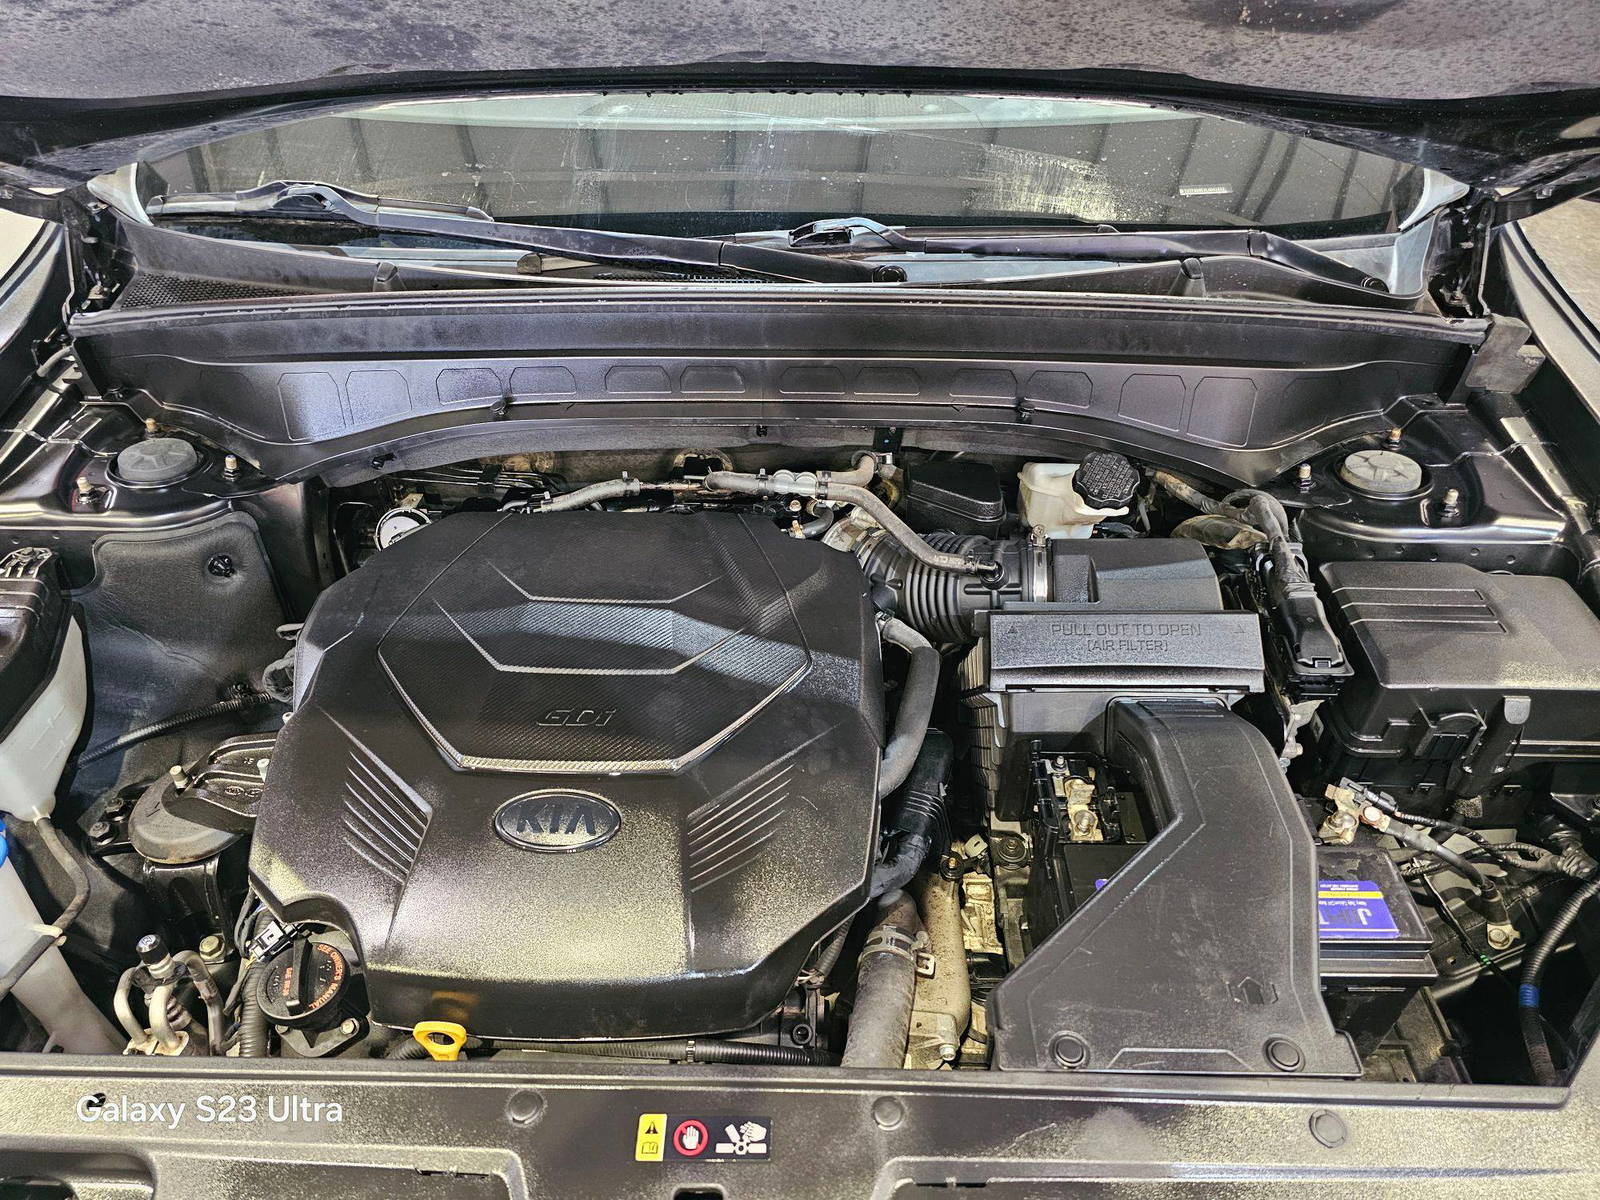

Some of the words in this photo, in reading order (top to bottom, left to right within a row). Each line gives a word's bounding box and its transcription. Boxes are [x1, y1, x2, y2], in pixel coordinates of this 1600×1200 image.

[1051, 623, 1091, 636] PULL
[1096, 623, 1128, 636] OUT
[1132, 623, 1154, 636] TO
[1158, 623, 1201, 636] OPEN
[516, 803, 597, 837] KIA
[317, 943, 332, 955] SEE
[309, 982, 338, 1009] MANUAL
